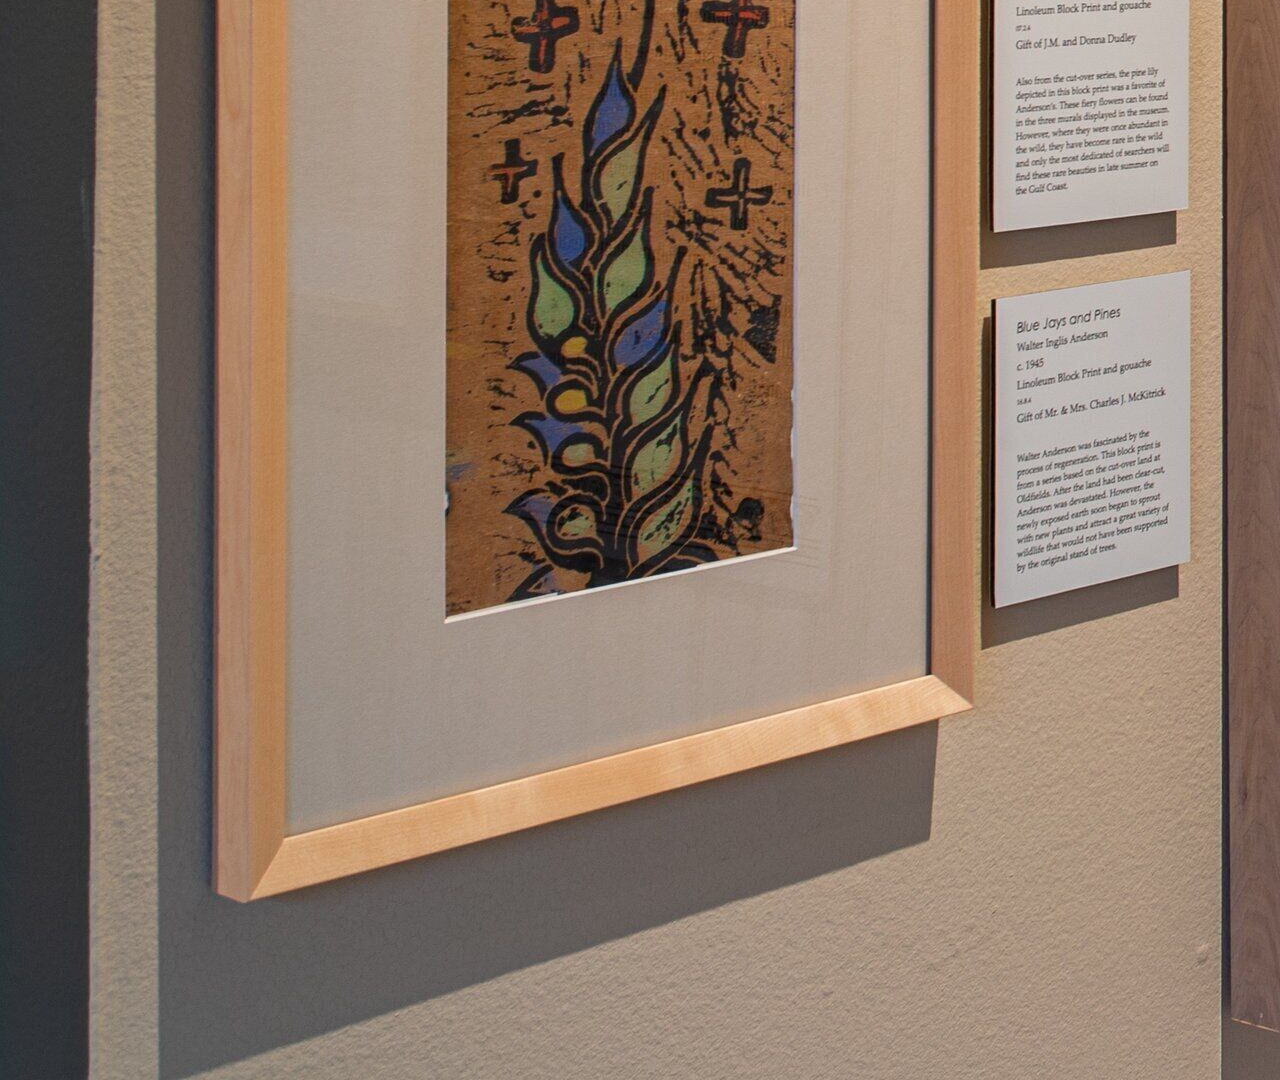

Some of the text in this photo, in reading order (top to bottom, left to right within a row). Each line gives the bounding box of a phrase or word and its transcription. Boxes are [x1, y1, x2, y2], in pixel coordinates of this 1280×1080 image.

[1016, 0, 1151, 16] Linoleum Block Print and gouache
[1015, 39, 1032, 49] Gift
[1062, 36, 1077, 46] and
[1079, 35, 1106, 45] Donna
[1107, 32, 1136, 44] Dudley
[1015, 77, 1032, 86] Also
[1034, 75, 1051, 84] from
[1053, 73, 1064, 83] the
[1065, 73, 1094, 82] cut-over
[1118, 69, 1129, 77] the
[1130, 70, 1146, 79] pine
[1147, 66, 1158, 77] lily
[1015, 89, 1046, 102] depicted
[1057, 87, 1069, 96] this
[1071, 85, 1090, 95] block
[1091, 85, 1109, 96] print
[1131, 80, 1157, 89] favorite
[1059, 100, 1079, 109] These
[1098, 97, 1124, 106] flowers
[1148, 91, 1168, 101] found
[1024, 117, 1036, 126] the
[1038, 115, 1055, 125] three
[1057, 112, 1081, 123] murals
[1083, 109, 1116, 122] displayed
[1127, 108, 1137, 116] the
[1051, 127, 1073, 136] where
[1075, 126, 1091, 136] they
[1128, 119, 1160, 129] abundant
[1015, 145, 1027, 154] the
[1048, 142, 1064, 152] they
[1065, 140, 1082, 149] have
[1083, 138, 1110, 147] become
[1135, 133, 1146, 142] the
[1147, 131, 1163, 140] wild
[1015, 158, 1029, 168] and
[1031, 156, 1047, 167] only
[1048, 155, 1060, 164] the
[1061, 154, 1078, 163] most
[1080, 149, 1113, 161] dedicated
[1124, 146, 1155, 156] searchers
[1156, 143, 1169, 152] will
[1015, 185, 1027, 195] the
[1028, 183, 1045, 193] Gulf
[1016, 308, 1120, 334] Blue Jays and Pines
[1016, 330, 1108, 351] Walter Inglis Anderson
[1016, 358, 1151, 390] Linoleum Block Print and gouache
[1025, 357, 1044, 370] 1945
[1016, 411, 1032, 423] Gift
[1044, 407, 1058, 418] Mr.
[1069, 402, 1088, 413] Mrs.
[1089, 396, 1119, 409] Charles
[1128, 386, 1166, 402] McKitrick
[1016, 452, 1040, 462] Walter
[1041, 445, 1076, 458] Anderson
[1077, 442, 1091, 450] was
[1093, 432, 1127, 447] fascinated
[1138, 429, 1149, 438] the
[1016, 480, 1033, 490] from
[1042, 475, 1061, 485] series
[1063, 468, 1083, 480] based
[1095, 464, 1106, 474] the
[1108, 459, 1136, 471] cut-over
[1137, 454, 1152, 465] land
[1052, 486, 1071, 496] After
[1073, 482, 1083, 492] the
[1085, 477, 1100, 489] land
[1102, 475, 1115, 485] had
[1117, 473, 1133, 482] been
[1016, 519, 1038, 531] newly
[1040, 511, 1069, 527] exposed
[1071, 507, 1089, 519] earth
[1090, 505, 1107, 515] soon
[1108, 500, 1129, 511] began
[1138, 493, 1160, 506] sprout
[1016, 533, 1033, 544] with
[1035, 531, 1050, 540] new
[1051, 526, 1073, 539] plants
[1074, 520, 1088, 531] and
[1118, 511, 1136, 524] great
[1137, 506, 1160, 517] variety
[1016, 515, 1168, 558] wildlife that would not have been supported
[1027, 560, 1038, 569] the
[1040, 551, 1067, 567] original
[1069, 546, 1088, 559] stand
